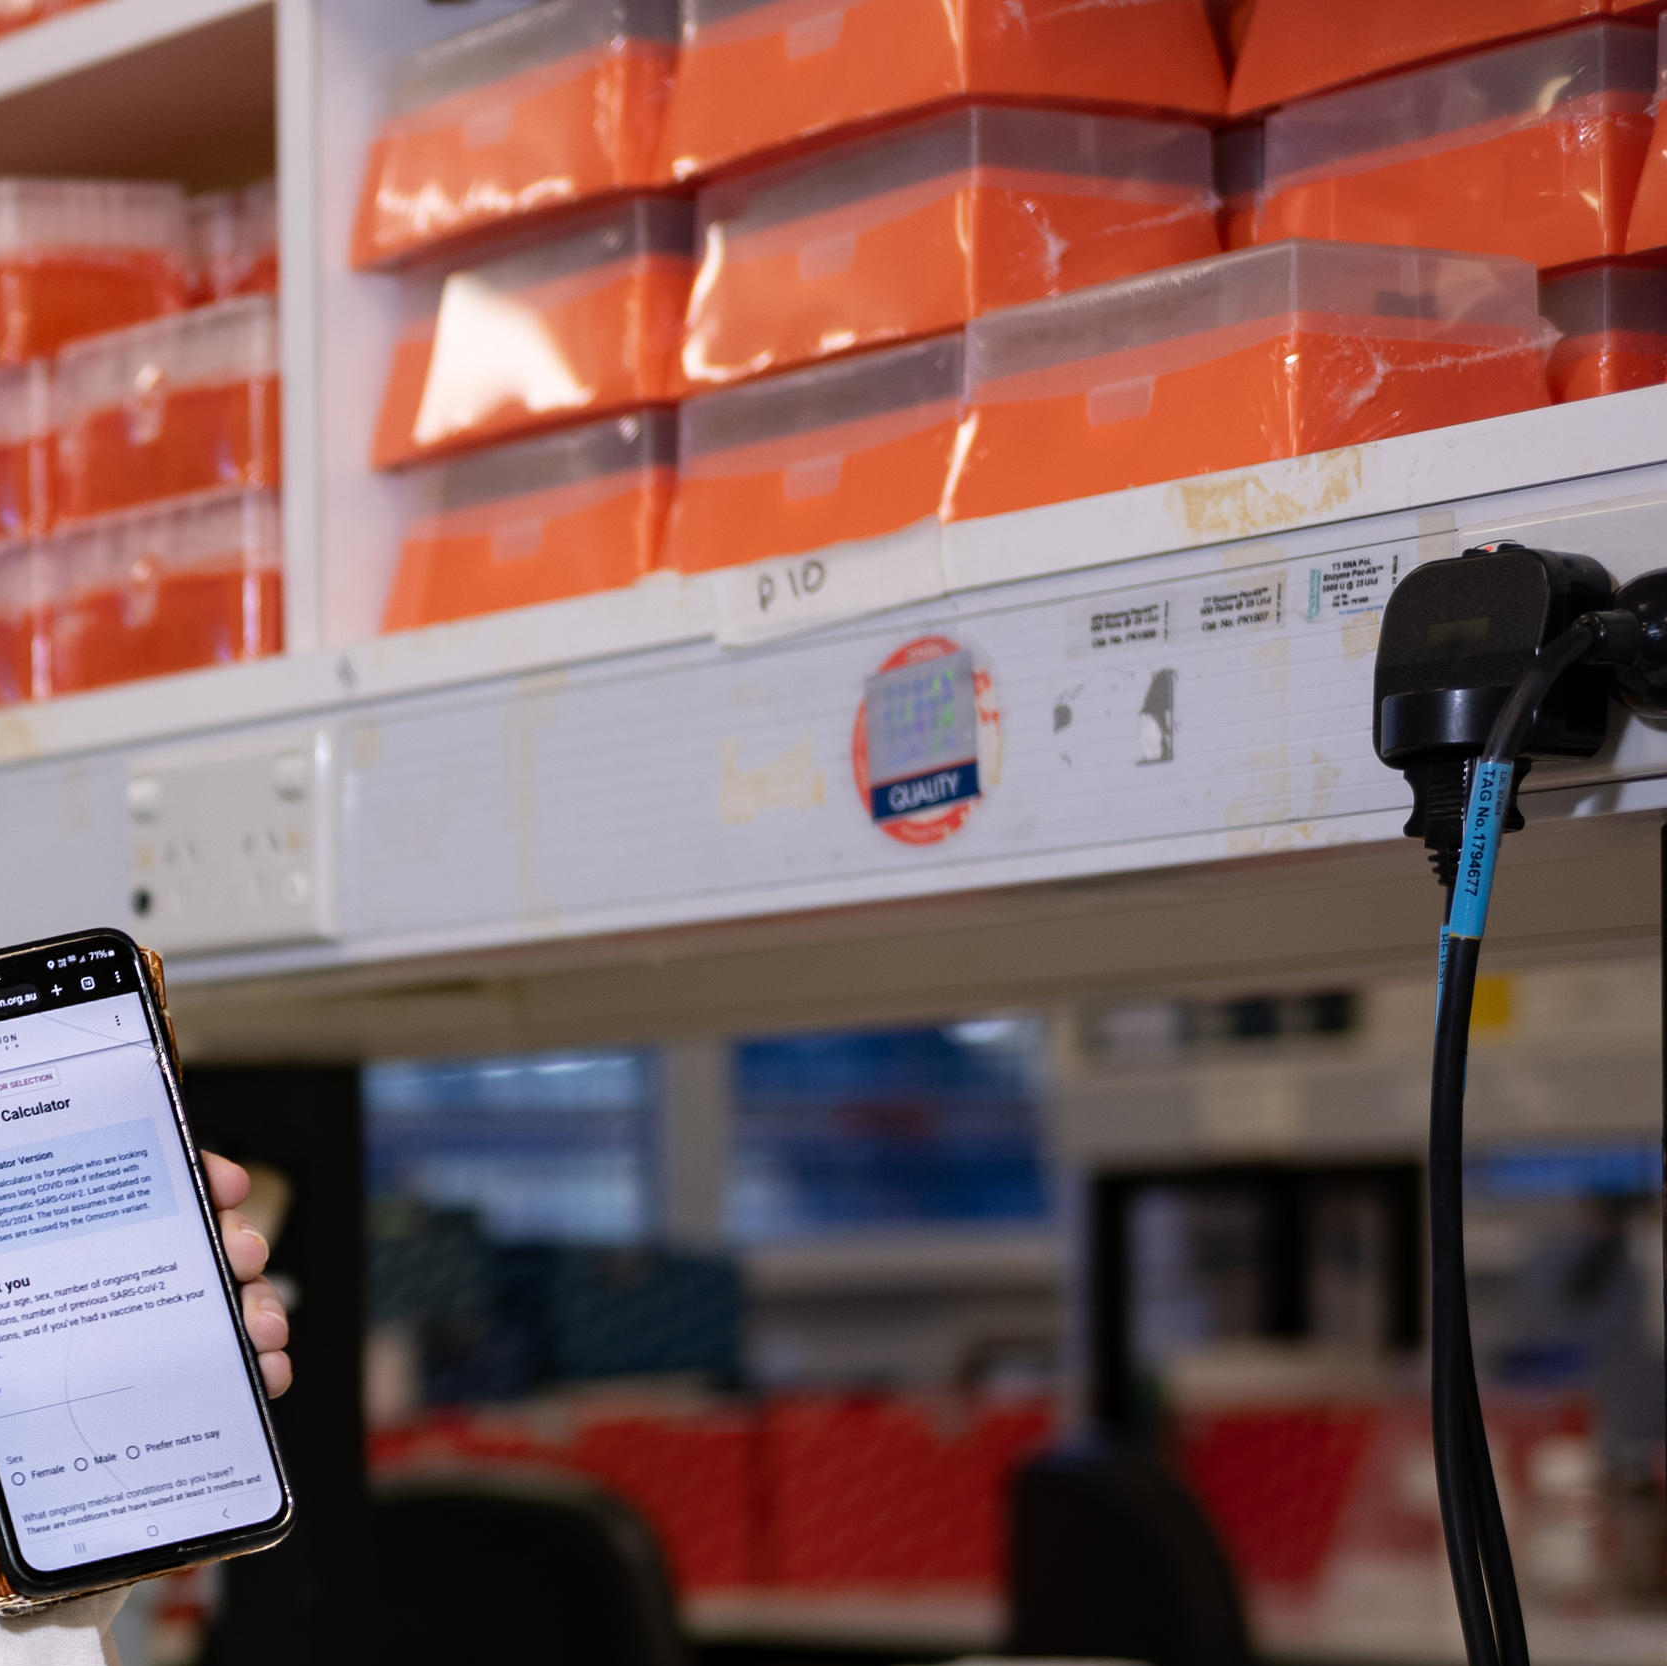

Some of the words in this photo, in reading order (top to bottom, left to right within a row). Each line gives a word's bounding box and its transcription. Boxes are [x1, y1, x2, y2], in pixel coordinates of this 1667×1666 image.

[1323, 571, 1350, 582] Enzyme
[1342, 560, 1357, 569] RNA
[888, 772, 960, 812] QUALITY
[1479, 768, 1496, 802] TAG
[88, 949, 107, 961] 71%
[9, 1073, 54, 1089] SELECTION
[1, 1098, 71, 1122] Calculator
[17, 1151, 54, 1165] Version
[34, 1172, 42, 1180] is
[43, 1169, 55, 1178] for
[56, 1162, 84, 1177] people
[85, 1159, 103, 1168] who
[103, 1156, 117, 1164] are
[117, 1149, 148, 1161] looking
[17, 1188, 37, 1197] long
[37, 1180, 64, 1193] COVID
[64, 1176, 79, 1186] risk
[81, 1174, 87, 1183] if
[88, 1167, 121, 1181] infected
[122, 1163, 140, 1174] with
[87, 1184, 105, 1195] Last
[106, 1177, 140, 1191] updated
[140, 1175, 152, 1184] on
[36, 1210, 52, 1220] The
[53, 1205, 69, 1216] tool
[70, 1198, 108, 1212] assumes
[107, 1193, 125, 1204] that
[125, 1190, 136, 1200] all
[136, 1188, 150, 1198] the
[14, 1229, 28, 1239] are
[28, 1221, 59, 1236] caused
[59, 1220, 69, 1230] by
[70, 1217, 84, 1226] the
[85, 1209, 120, 1222] Omicron
[120, 1202, 150, 1214] variant.
[5, 1277, 31, 1294] you
[34, 1292, 53, 1302] sex,
[54, 1283, 89, 1297] number
[90, 1278, 101, 1289] of
[102, 1271, 141, 1286] ongoing
[141, 1261, 178, 1278] medical
[21, 1306, 56, 1321] number
[58, 1302, 68, 1313] of
[69, 1295, 109, 1312] previous
[109, 1281, 166, 1301] SARS-CoV-2
[22, 1325, 41, 1338] and
[42, 1323, 49, 1334] if
[50, 1318, 80, 1332] you've
[80, 1312, 99, 1325] had
[107, 1303, 143, 1318] vaccine
[144, 1300, 155, 1309] to
[156, 1293, 184, 1308] check
[184, 1289, 205, 1303] your
[5, 1455, 23, 1465] Sex
[31, 1464, 65, 1480] Female
[94, 1452, 117, 1465] Male
[145, 1440, 174, 1453] Prefer
[175, 1436, 192, 1447] not
[192, 1432, 203, 1442] to
[204, 1429, 220, 1440] say
[21, 1509, 47, 1523] What
[48, 1502, 87, 1517] ongoing
[87, 1491, 124, 1508] medical
[125, 1481, 174, 1501] conditions
[175, 1478, 188, 1488] do
[189, 1474, 207, 1487] you
[207, 1466, 234, 1480] have?
[25, 1522, 51, 1536] These
[52, 1519, 66, 1529] are
[66, 1510, 110, 1527] conditions
[110, 1505, 128, 1517] that
[127, 1501, 148, 1512] have
[148, 1494, 175, 1507] lasted
[175, 1492, 184, 1501] at
[184, 1487, 206, 1499] least
[206, 1486, 213, 1494] 3
[213, 1479, 244, 1493] months
[245, 1474, 262, 1485] and
